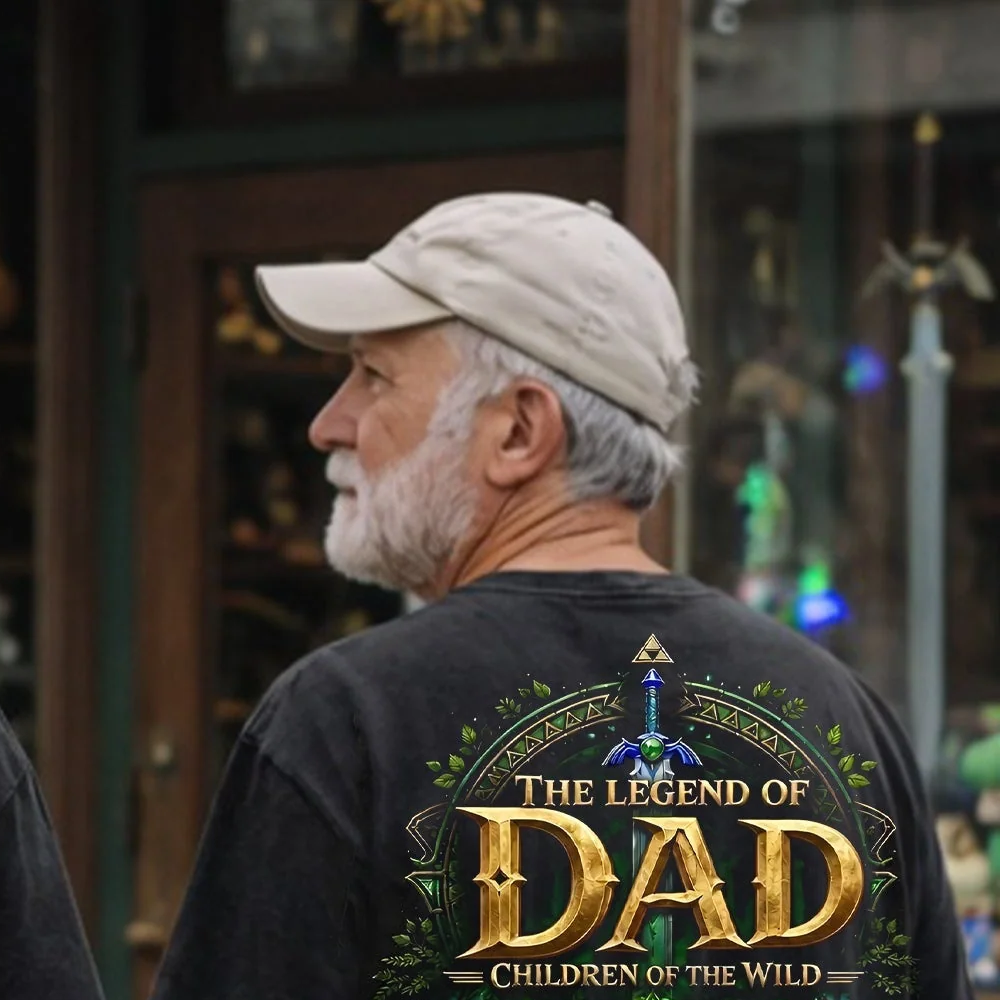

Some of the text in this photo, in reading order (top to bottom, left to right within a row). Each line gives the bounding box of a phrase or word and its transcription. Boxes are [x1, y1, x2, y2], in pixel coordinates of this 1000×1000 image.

[515, 775, 810, 806] THE LEGEND OF
[455, 806, 865, 959] DAD
[490, 961, 822, 988] CHILDREN OF THE WILD
